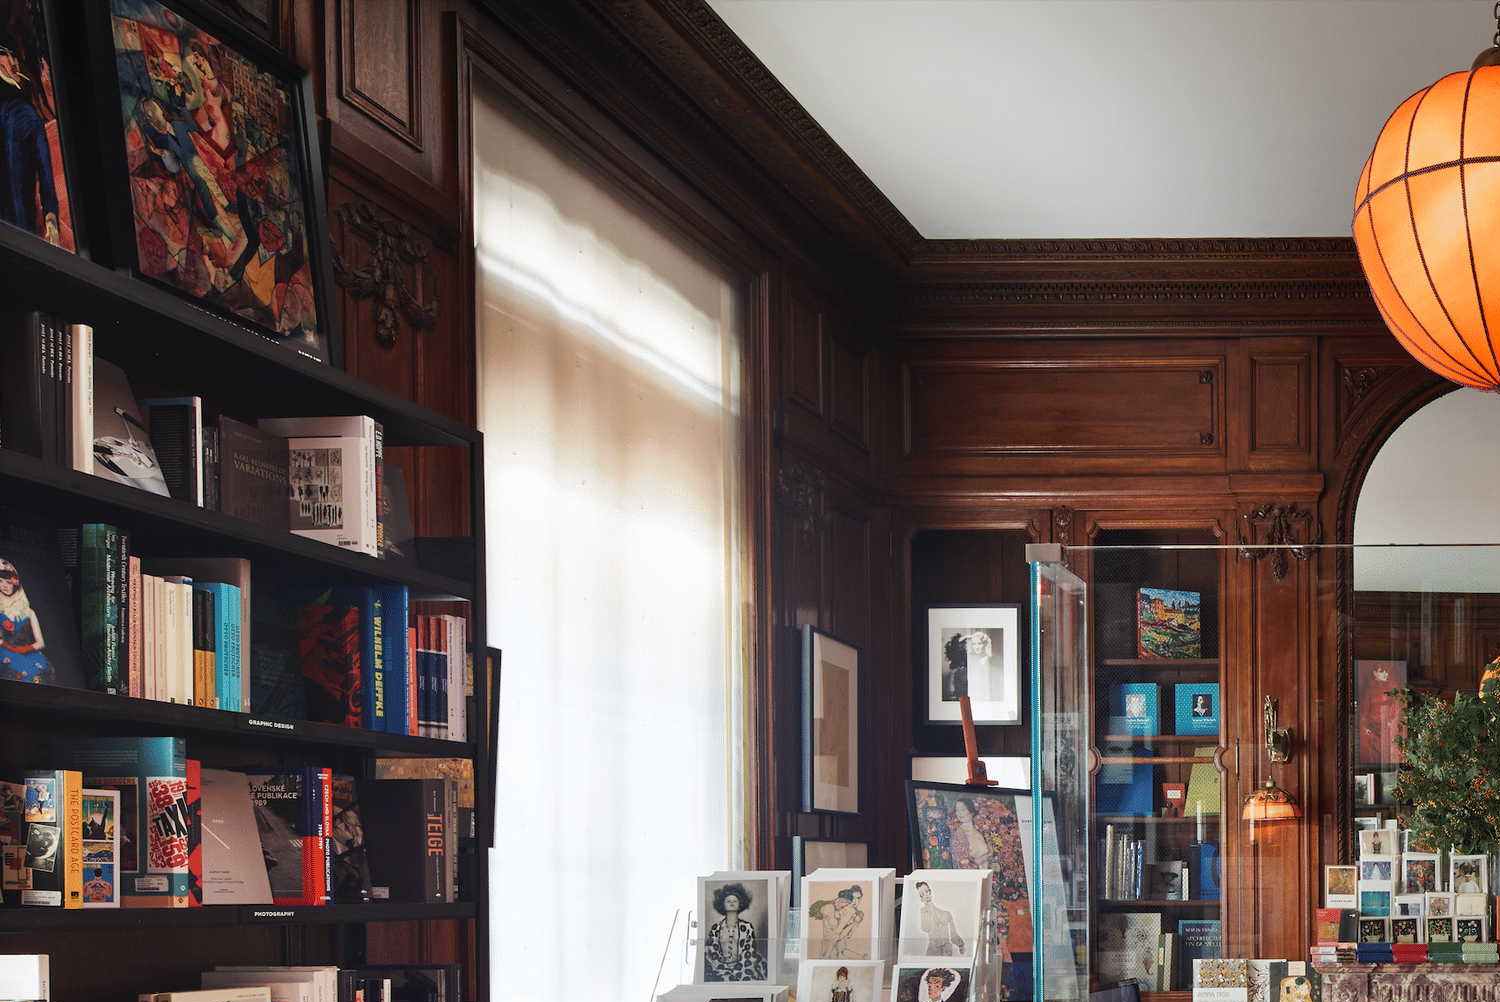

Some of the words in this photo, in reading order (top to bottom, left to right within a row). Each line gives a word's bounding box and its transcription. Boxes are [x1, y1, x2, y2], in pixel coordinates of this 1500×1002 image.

[233, 460, 287, 485] VARIATIONS
[120, 535, 128, 561] Twentieth
[119, 561, 128, 582] Century
[120, 583, 128, 603] Textiles
[373, 616, 383, 669] WILHELM
[374, 671, 384, 718] DEFFKE
[248, 718, 272, 729] GRAPHIC
[70, 790, 79, 805] THE
[257, 792, 298, 800] PUBLIKACE
[69, 807, 79, 854] POSTCARD
[427, 813, 444, 857] TEIGE
[70, 856, 79, 874] AGE
